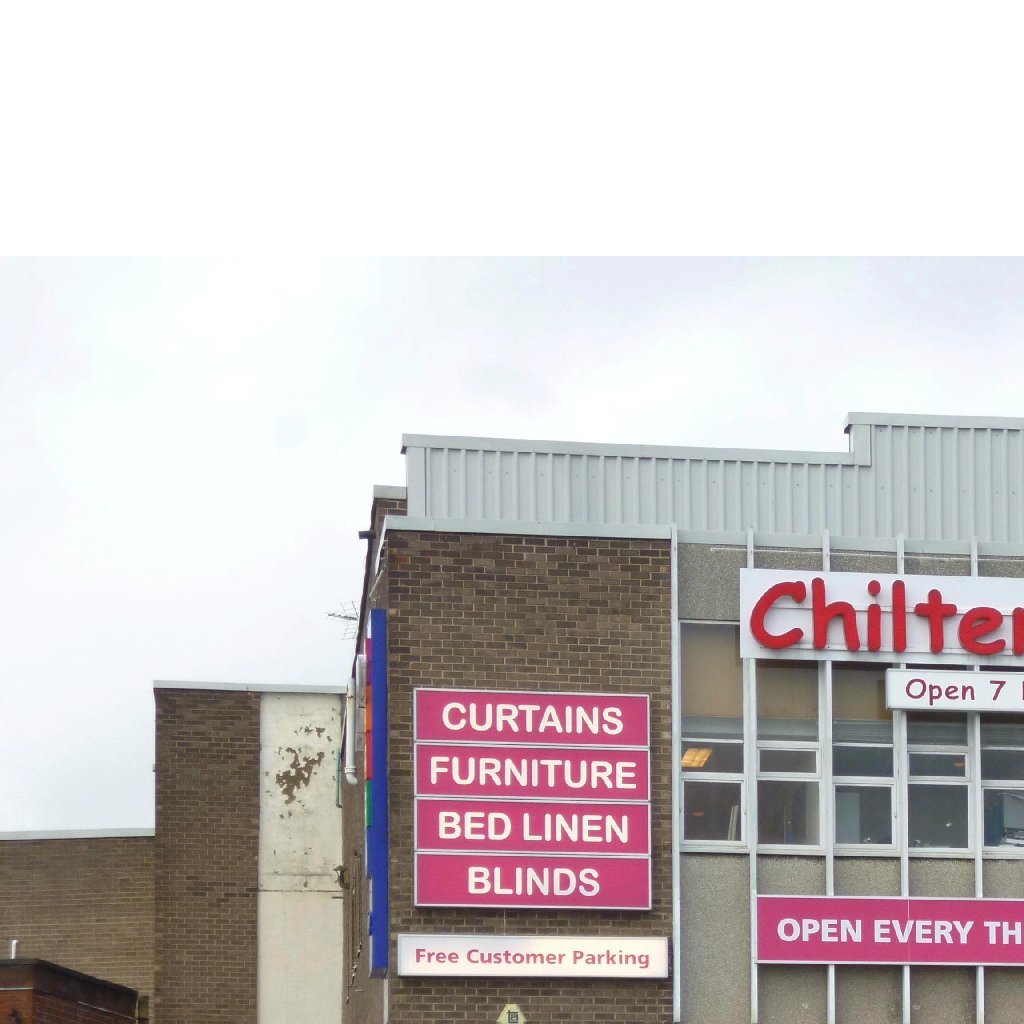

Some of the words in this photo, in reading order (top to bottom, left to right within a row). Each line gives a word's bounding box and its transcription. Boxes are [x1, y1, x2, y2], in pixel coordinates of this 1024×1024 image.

[905, 678, 976, 707] Open
[990, 680, 1007, 701] 7
[441, 702, 624, 735] CURTAINS
[430, 756, 637, 789] FURNITURE
[438, 811, 512, 841] BED
[522, 812, 628, 844] LINEN
[467, 866, 600, 897] BLINDS
[776, 917, 862, 943] OPEN
[874, 918, 974, 944] EVERY
[415, 948, 459, 964] Free
[466, 949, 566, 965] Customer
[572, 950, 650, 969] Parking
